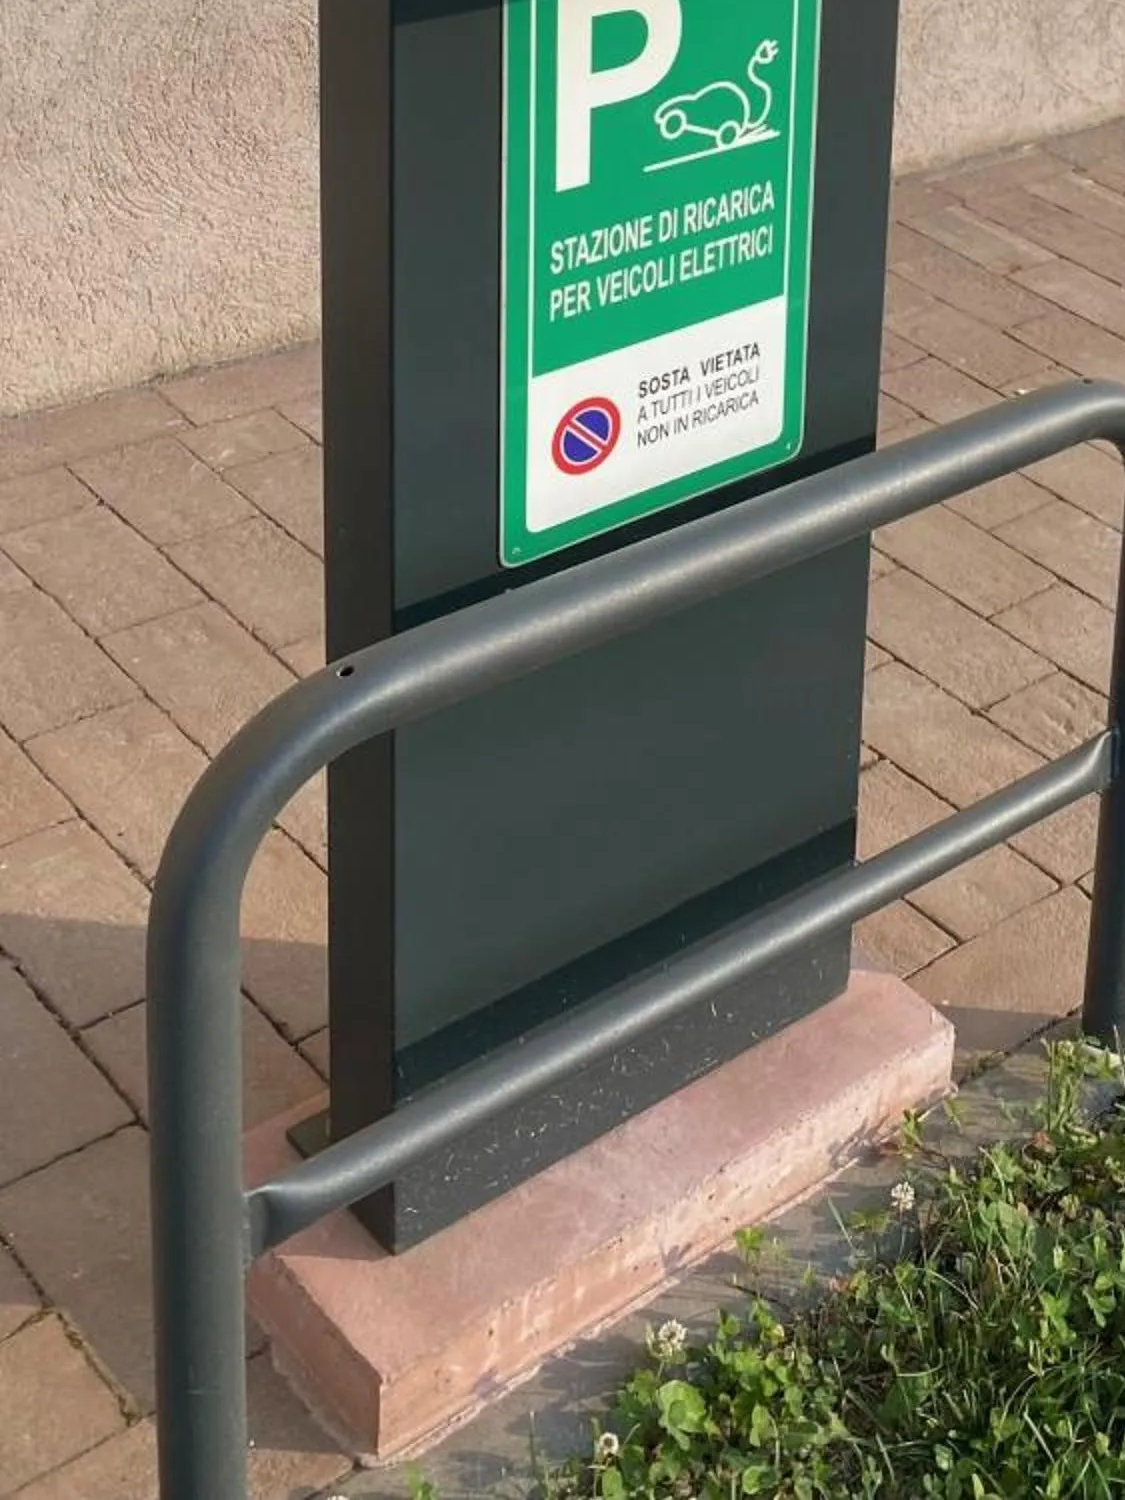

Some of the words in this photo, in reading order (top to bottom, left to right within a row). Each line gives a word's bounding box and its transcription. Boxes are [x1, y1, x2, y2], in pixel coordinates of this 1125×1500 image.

[550, 215, 653, 274] STAZIONE
[658, 208, 678, 243] DI
[683, 180, 775, 235] RICARICA
[550, 281, 591, 322] PER
[596, 254, 675, 307] VEICOLI
[680, 224, 774, 281] ELETTRICI
[637, 405, 648, 425] A
[651, 389, 693, 418] TUTTI
[704, 364, 759, 400] VEICOLI
[639, 366, 690, 399] SOSTA
[700, 341, 760, 377] VIETATA
[637, 421, 669, 448] NON
[673, 414, 689, 435] IN
[691, 390, 760, 429] RICARICA
